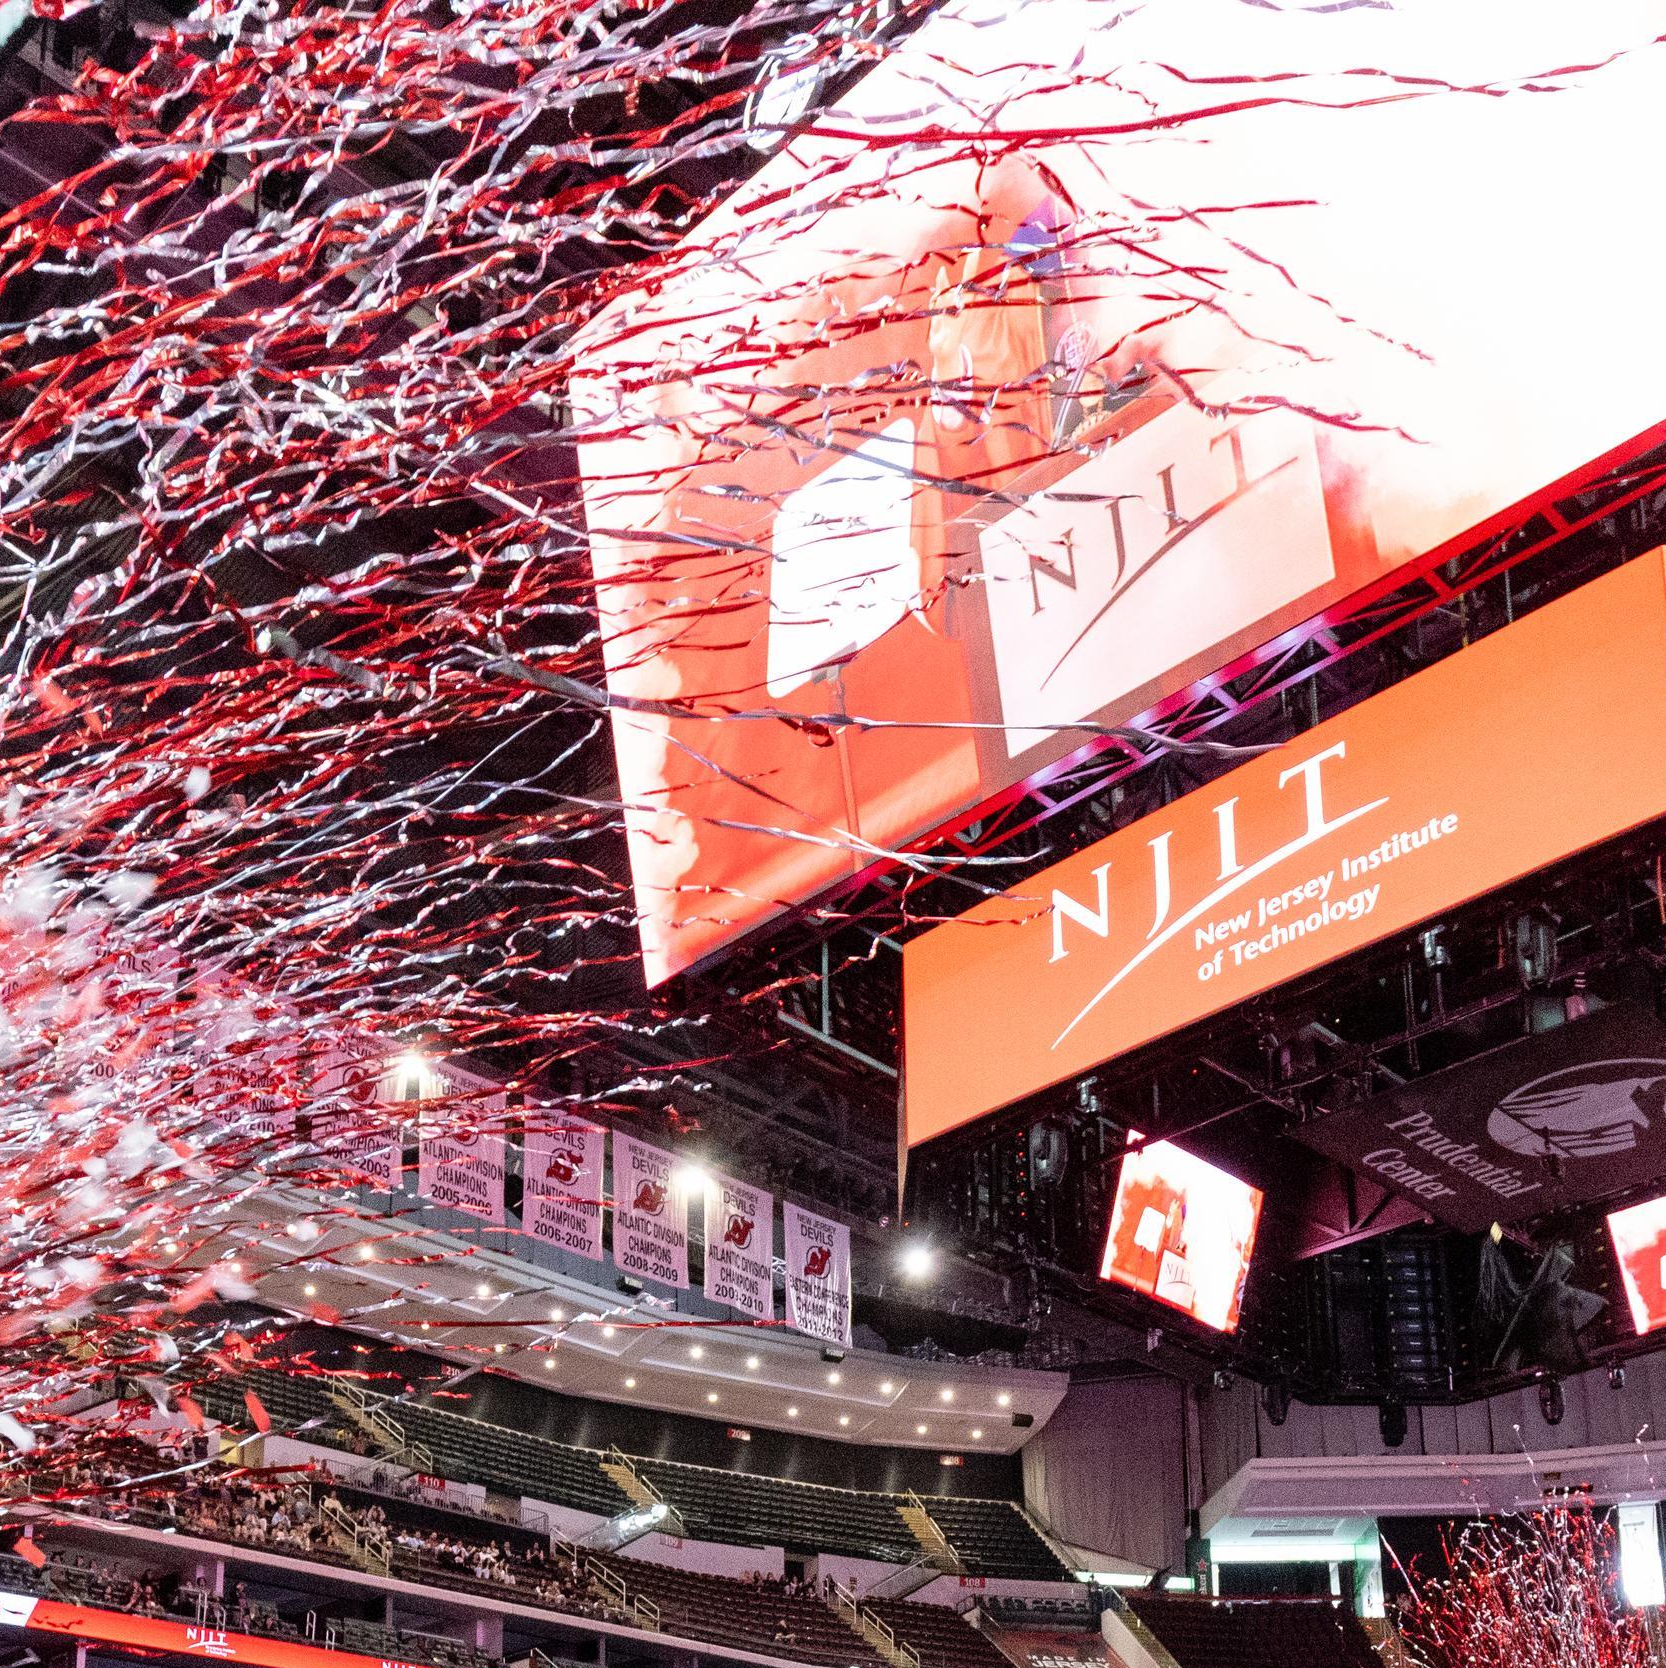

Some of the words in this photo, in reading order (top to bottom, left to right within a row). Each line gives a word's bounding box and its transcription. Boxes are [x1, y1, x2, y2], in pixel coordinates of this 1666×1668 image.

[1048, 740, 1347, 964] NJIT
[1194, 907, 1252, 951] New
[1257, 869, 1335, 928] Jersey
[1340, 811, 1459, 881] Institute
[1197, 953, 1223, 982] of
[1228, 882, 1381, 966] Technology
[628, 1143, 645, 1157] NEW
[1384, 1110, 1543, 1199] Prudential
[436, 1165, 488, 1198] CHAMPIONS
[632, 1156, 670, 1181] DEVILS
[1361, 1148, 1457, 1200] Center
[539, 1202, 588, 1234] CHAMPIONS
[723, 1190, 756, 1217] DEVILS
[533, 1220, 593, 1253] 2006-2007
[617, 1210, 652, 1237] ATLANTIC
[653, 1224, 685, 1248] DIVISION
[800, 1223, 834, 1247] DEVILS
[628, 1235, 672, 1265] CHAMPIONS
[708, 1243, 740, 1270] ATLANTIC
[741, 1256, 771, 1282] DIVISION
[623, 1251, 679, 1282] 2008-2009
[186, 1627, 227, 1644] NJIT
[1027, 1654, 1077, 1663] MADE
